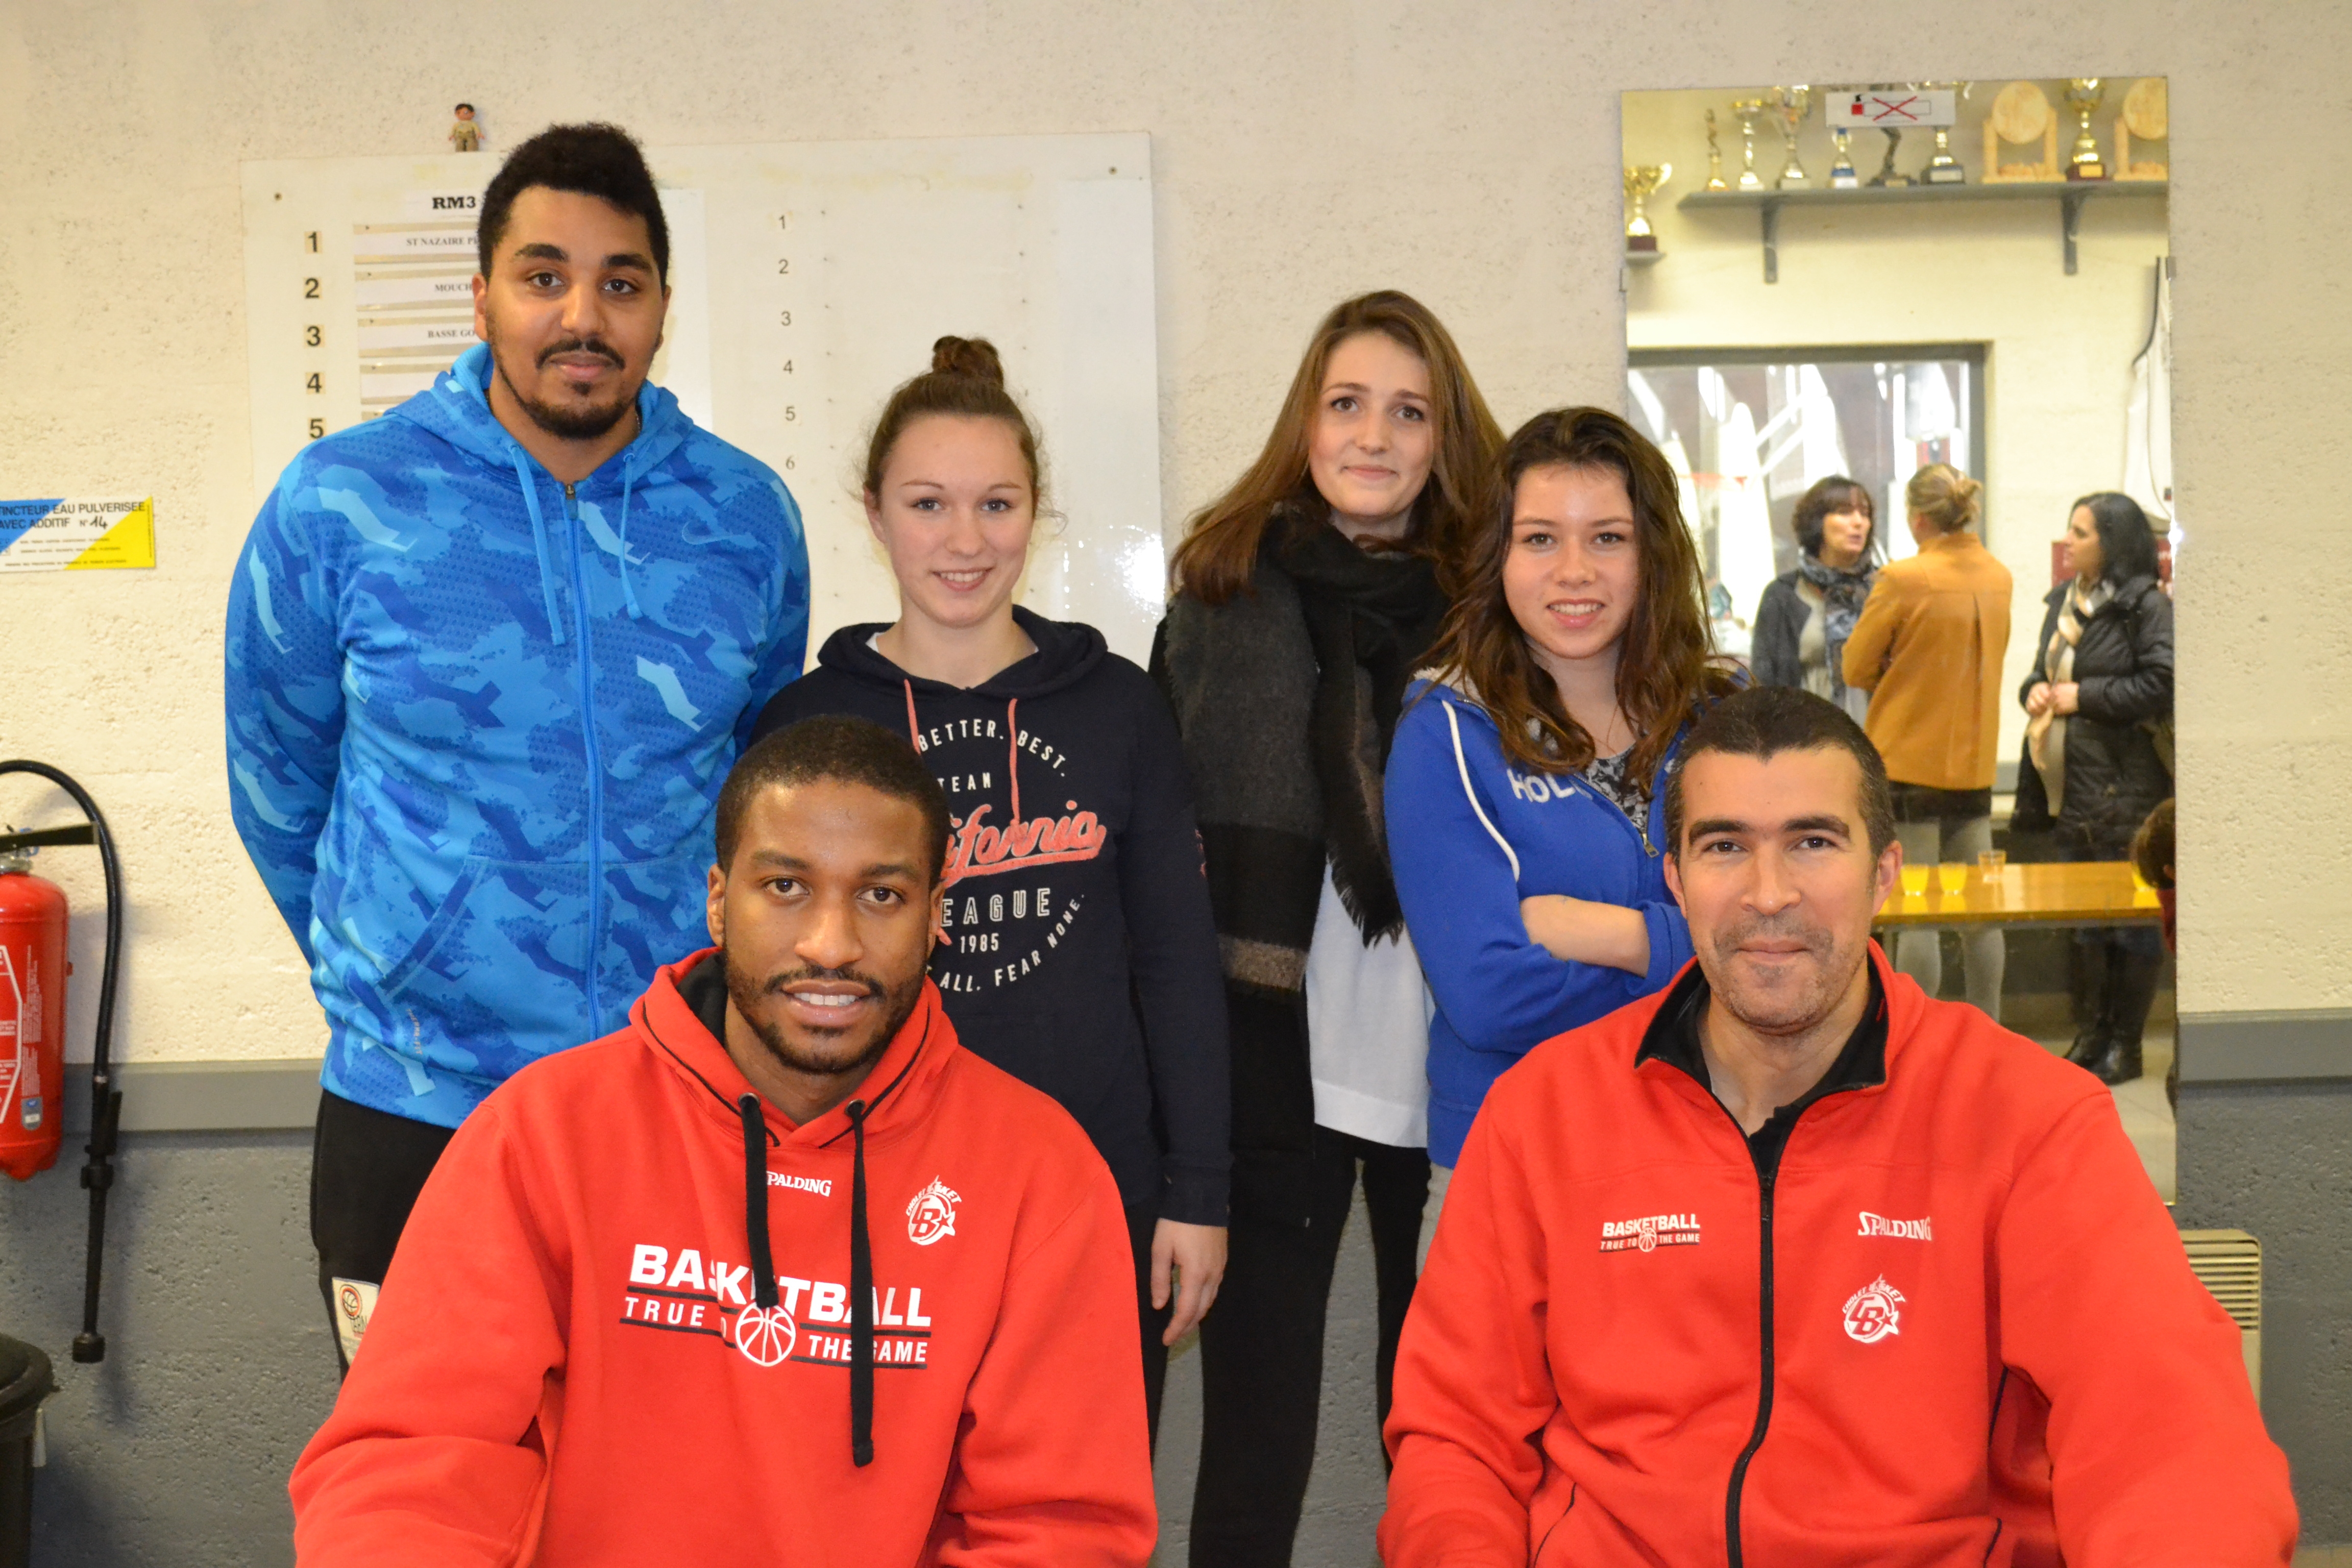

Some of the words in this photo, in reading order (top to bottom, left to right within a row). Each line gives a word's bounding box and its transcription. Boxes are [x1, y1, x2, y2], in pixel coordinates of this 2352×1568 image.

[432, 195, 476, 209] RM3
[779, 215, 785, 229] 1
[308, 231, 317, 252] 1
[406, 238, 418, 246] ST
[421, 237, 464, 246] NAZAIRE
[778, 258, 789, 274] 2
[305, 278, 320, 299] 2
[781, 310, 791, 326] 3
[306, 326, 321, 347] 3
[428, 330, 457, 338] BASSE
[783, 359, 793, 374] 4
[307, 373, 322, 394] 4
[786, 406, 796, 421] 5
[309, 418, 324, 439] 5
[786, 455, 795, 470] 6
[53, 504, 75, 514] EAU
[79, 501, 145, 513] PULVERISEE
[30, 518, 70, 528] ADDITIF
[90, 516, 108, 530] 14
[918, 718, 1004, 752] BETTER.
[1016, 729, 1066, 777] BEST.
[943, 800, 1107, 872] ifornia
[941, 888, 1050, 927] EAGUE
[940, 972, 981, 992] ALL.
[995, 950, 1041, 986] FEAR
[1047, 894, 1085, 948] NONE.
[960, 933, 999, 953] 1985
[766, 1170, 832, 1197] PALDING
[1602, 1213, 1701, 1237] BASKETBALL
[1857, 1211, 1932, 1241] SPALDING
[1600, 1240, 1625, 1250] TRUE
[1628, 1238, 1637, 1246] TO
[1659, 1235, 1673, 1244] THE
[1676, 1233, 1700, 1243] GAME
[624, 1296, 705, 1327] TRUE
[808, 1334, 852, 1361] THE
